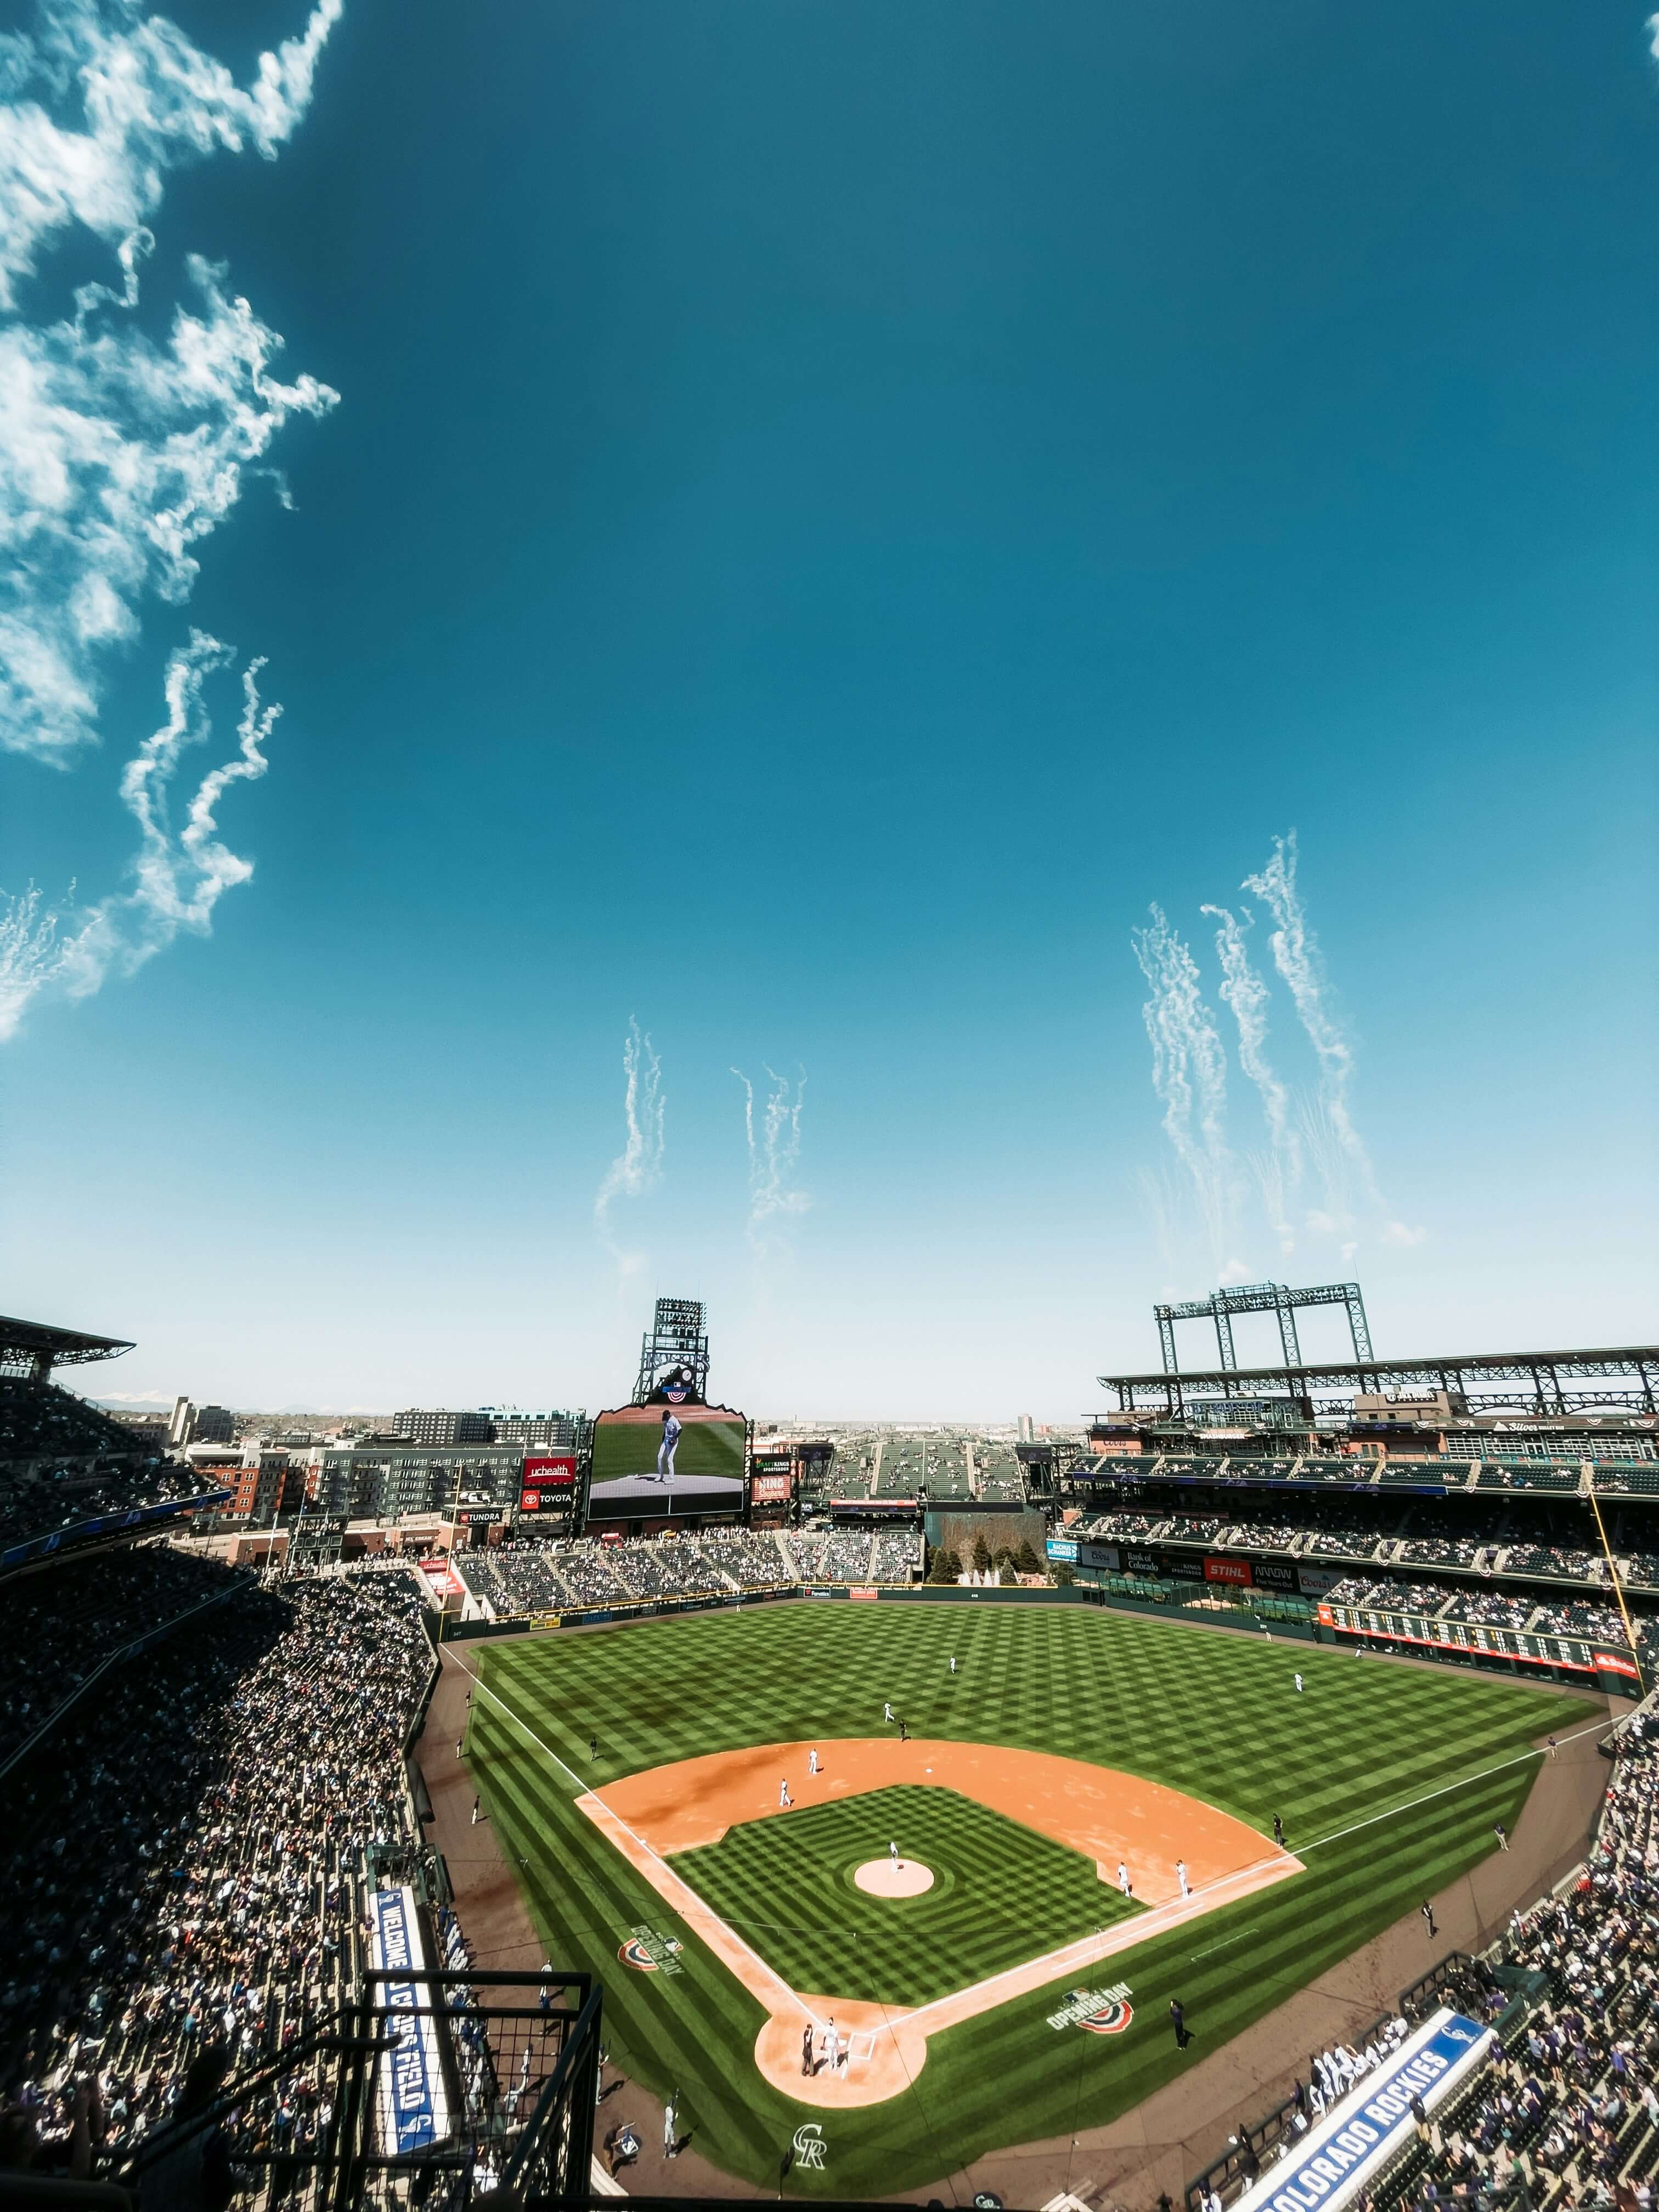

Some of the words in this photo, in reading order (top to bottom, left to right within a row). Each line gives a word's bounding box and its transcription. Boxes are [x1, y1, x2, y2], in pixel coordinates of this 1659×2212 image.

[1509, 1422, 1538, 1431] Silver
[531, 1464, 568, 1476] uchealth
[540, 1494, 572, 1503] TOYOTA
[469, 1513, 500, 1521] TUNDRA
[1091, 1550, 1110, 1561] Coors
[1128, 1552, 1144, 1561] Bank
[1144, 1553, 1152, 1562] of
[1128, 1560, 1159, 1571] Colorado
[1171, 1568, 1202, 1576] SPORTSBOOK
[1210, 1565, 1245, 1578] STIHL
[1300, 1575, 1327, 1589] Coors
[631, 1925, 670, 1961] OPENING
[658, 1957, 685, 1976] DAY
[382, 1905, 408, 1970] WELCOME
[396, 2049, 426, 2110] FIELD
[1046, 1994, 1110, 2030] OPENING
[1102, 1981, 1134, 2003] DAY
[1262, 2120, 1379, 2212] OLORADO
[1364, 2050, 1449, 2126] ROCKIES
